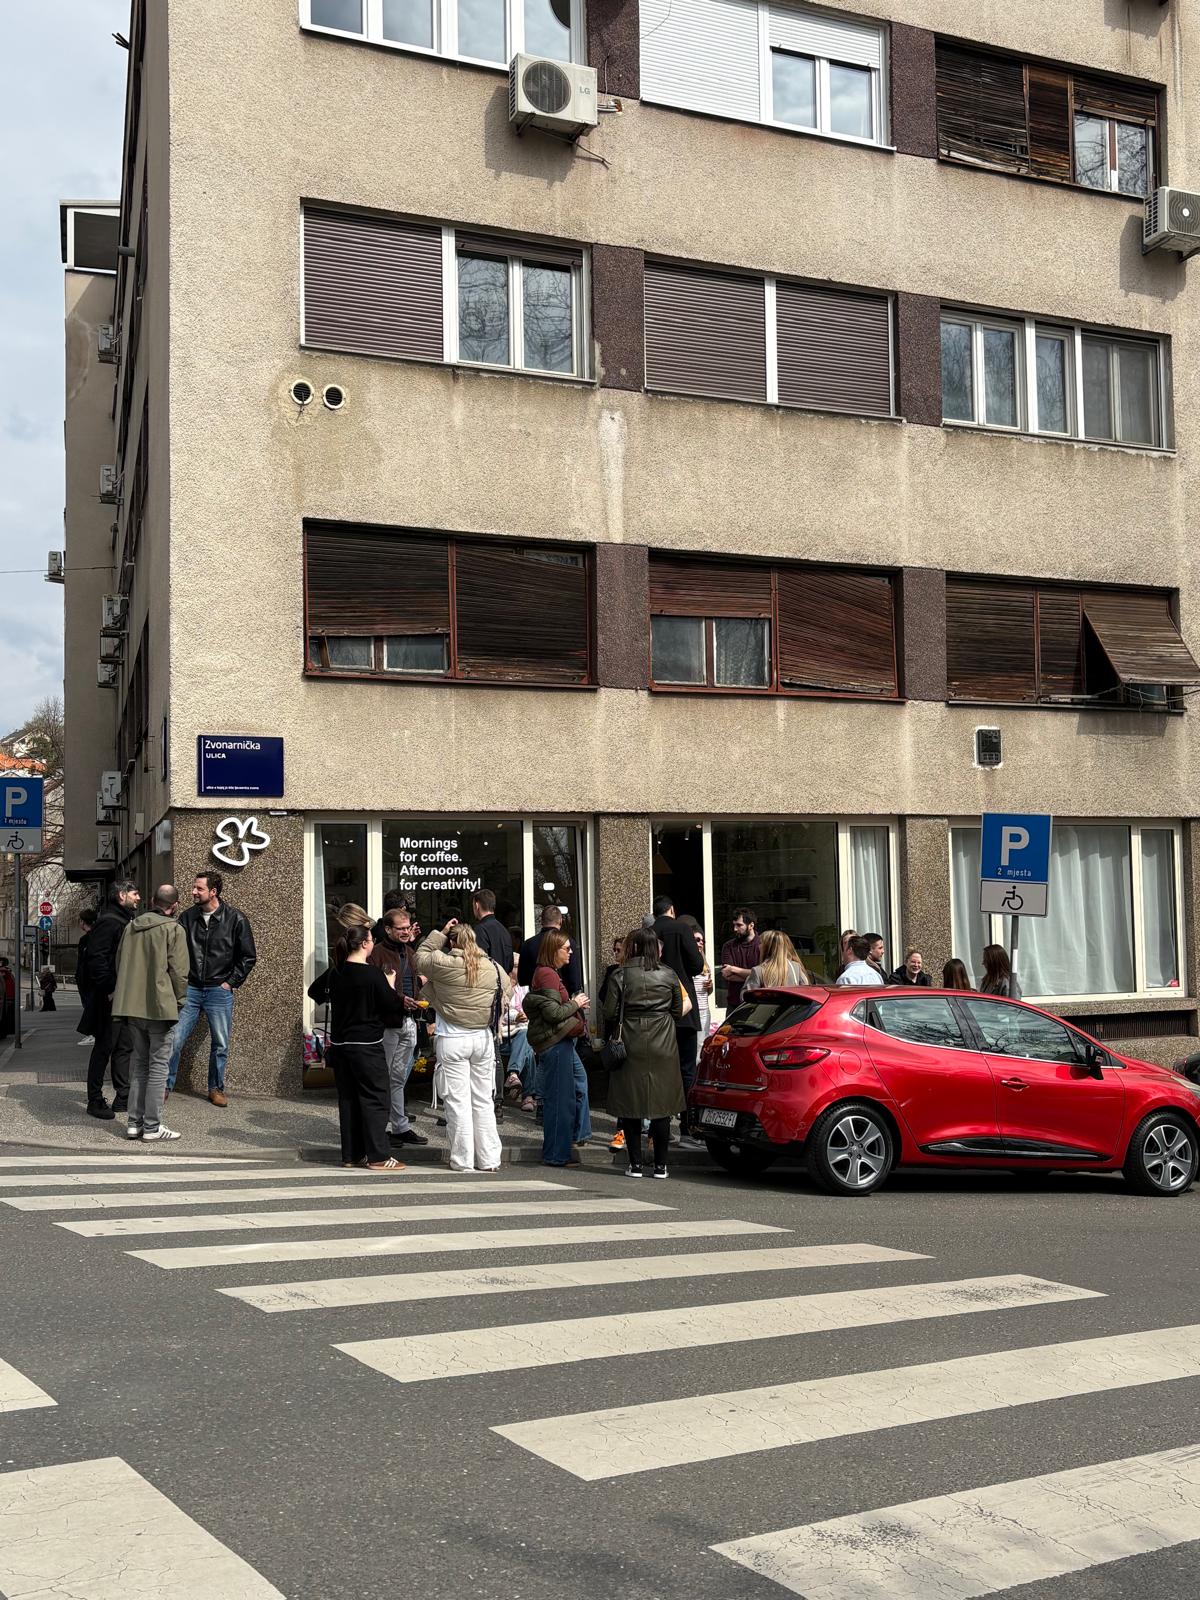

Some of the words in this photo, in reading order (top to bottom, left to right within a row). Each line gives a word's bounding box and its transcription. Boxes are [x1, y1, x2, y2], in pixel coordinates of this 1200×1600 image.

[579, 86, 591, 95] LG
[205, 740, 261, 750] Zvonarnička
[5, 786, 28, 818] P
[400, 837, 458, 851] Mornings
[1001, 826, 1030, 866] P
[400, 851, 418, 862] for
[420, 851, 462, 862] coffee.
[400, 865, 469, 876] Afternoons
[997, 867, 1002, 876] 2
[1007, 868, 1032, 878] mjesta
[400, 879, 418, 890] for
[421, 878, 481, 892] creativity!
